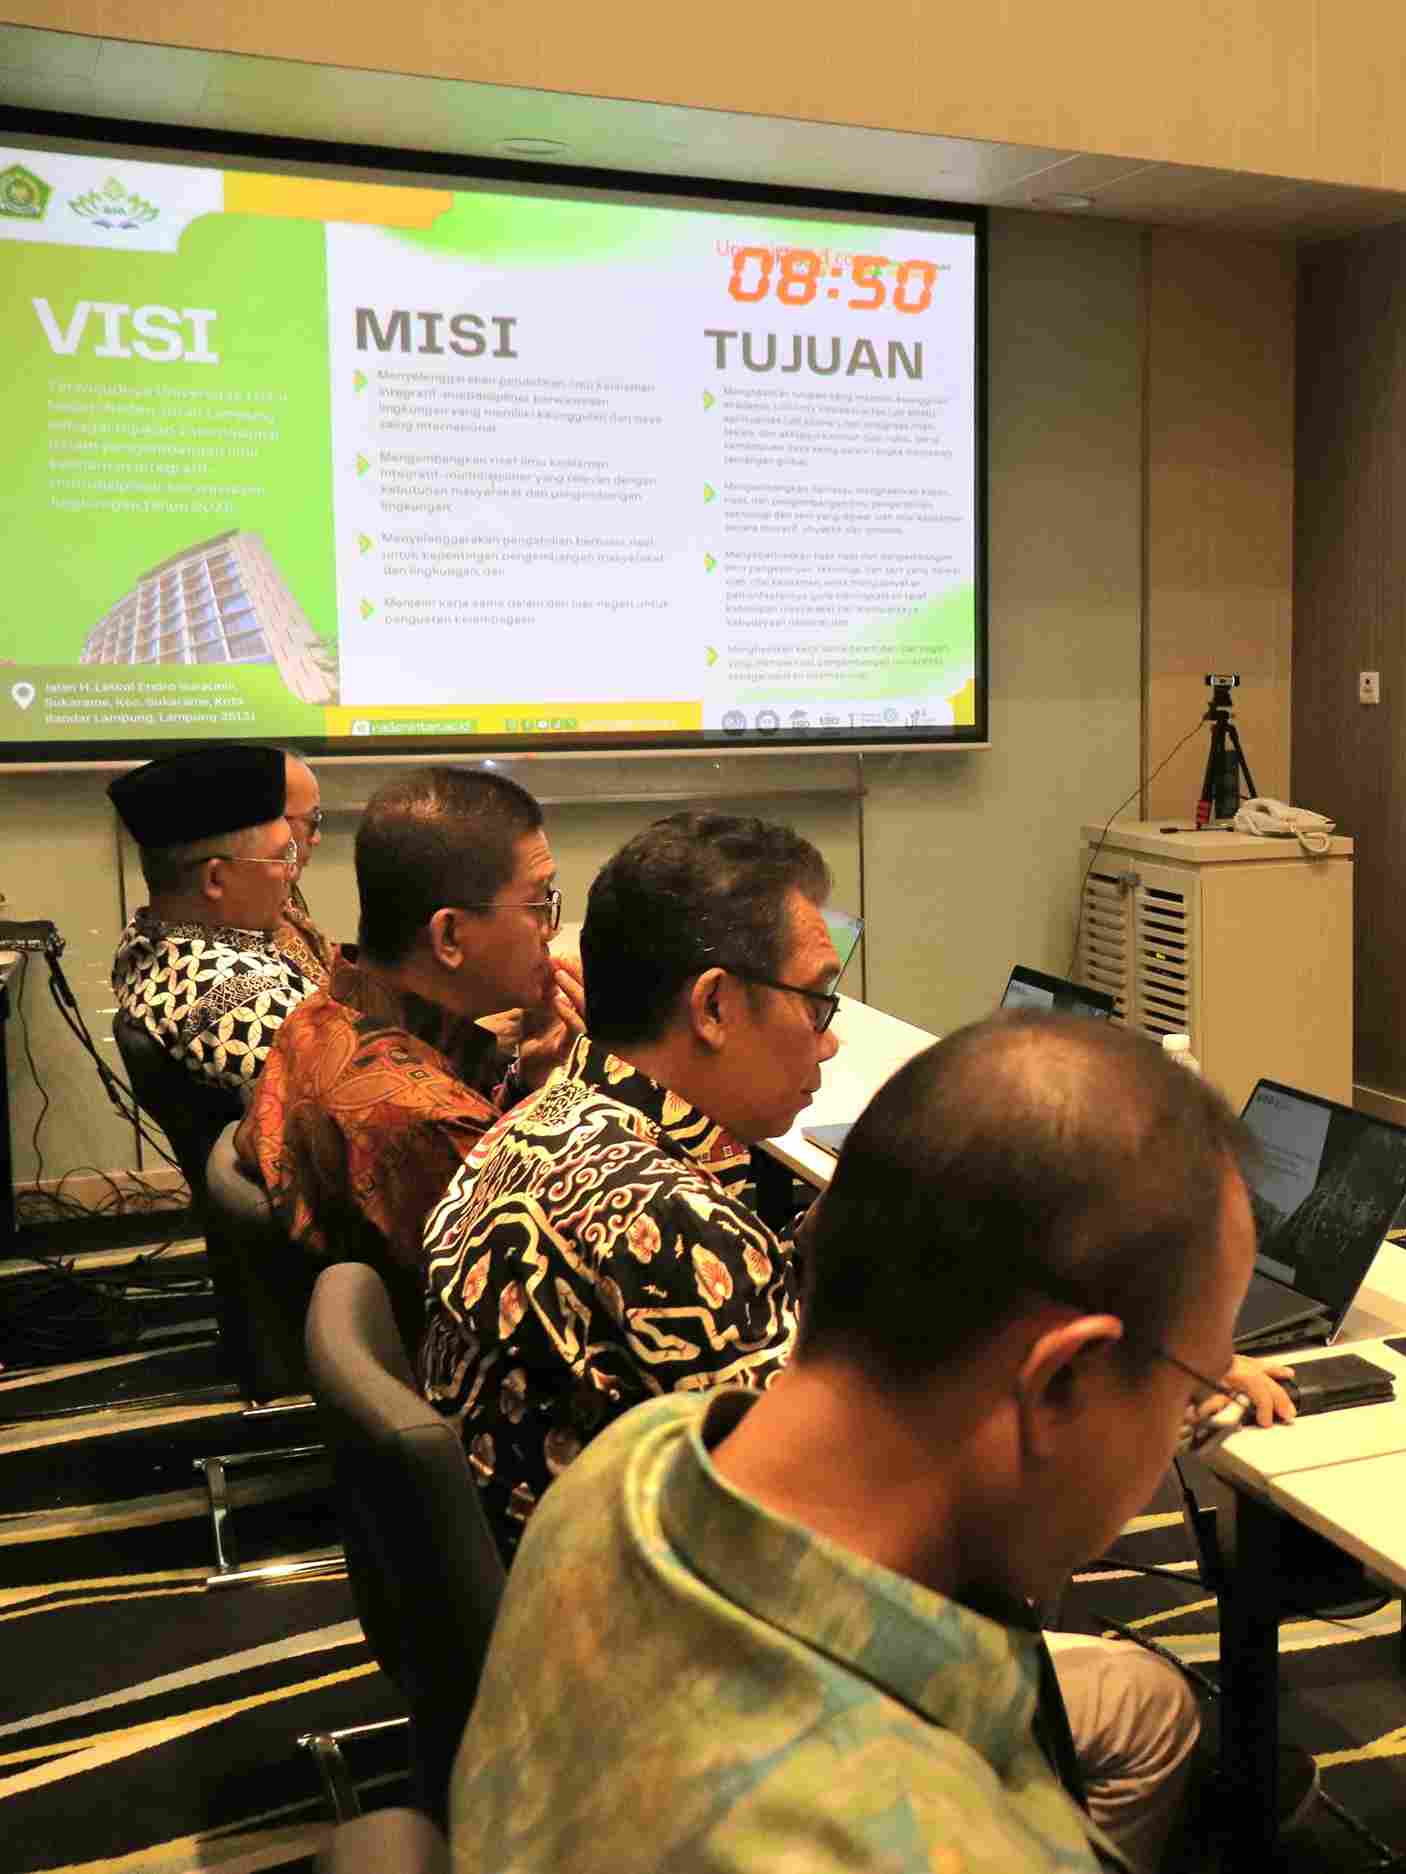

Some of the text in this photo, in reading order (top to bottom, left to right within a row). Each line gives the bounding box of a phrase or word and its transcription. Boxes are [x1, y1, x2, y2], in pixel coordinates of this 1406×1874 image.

[728, 248, 937, 315] 08:50
[32, 297, 220, 364] VISI
[355, 307, 518, 357] MISI
[703, 329, 923, 379] TUJUAN
